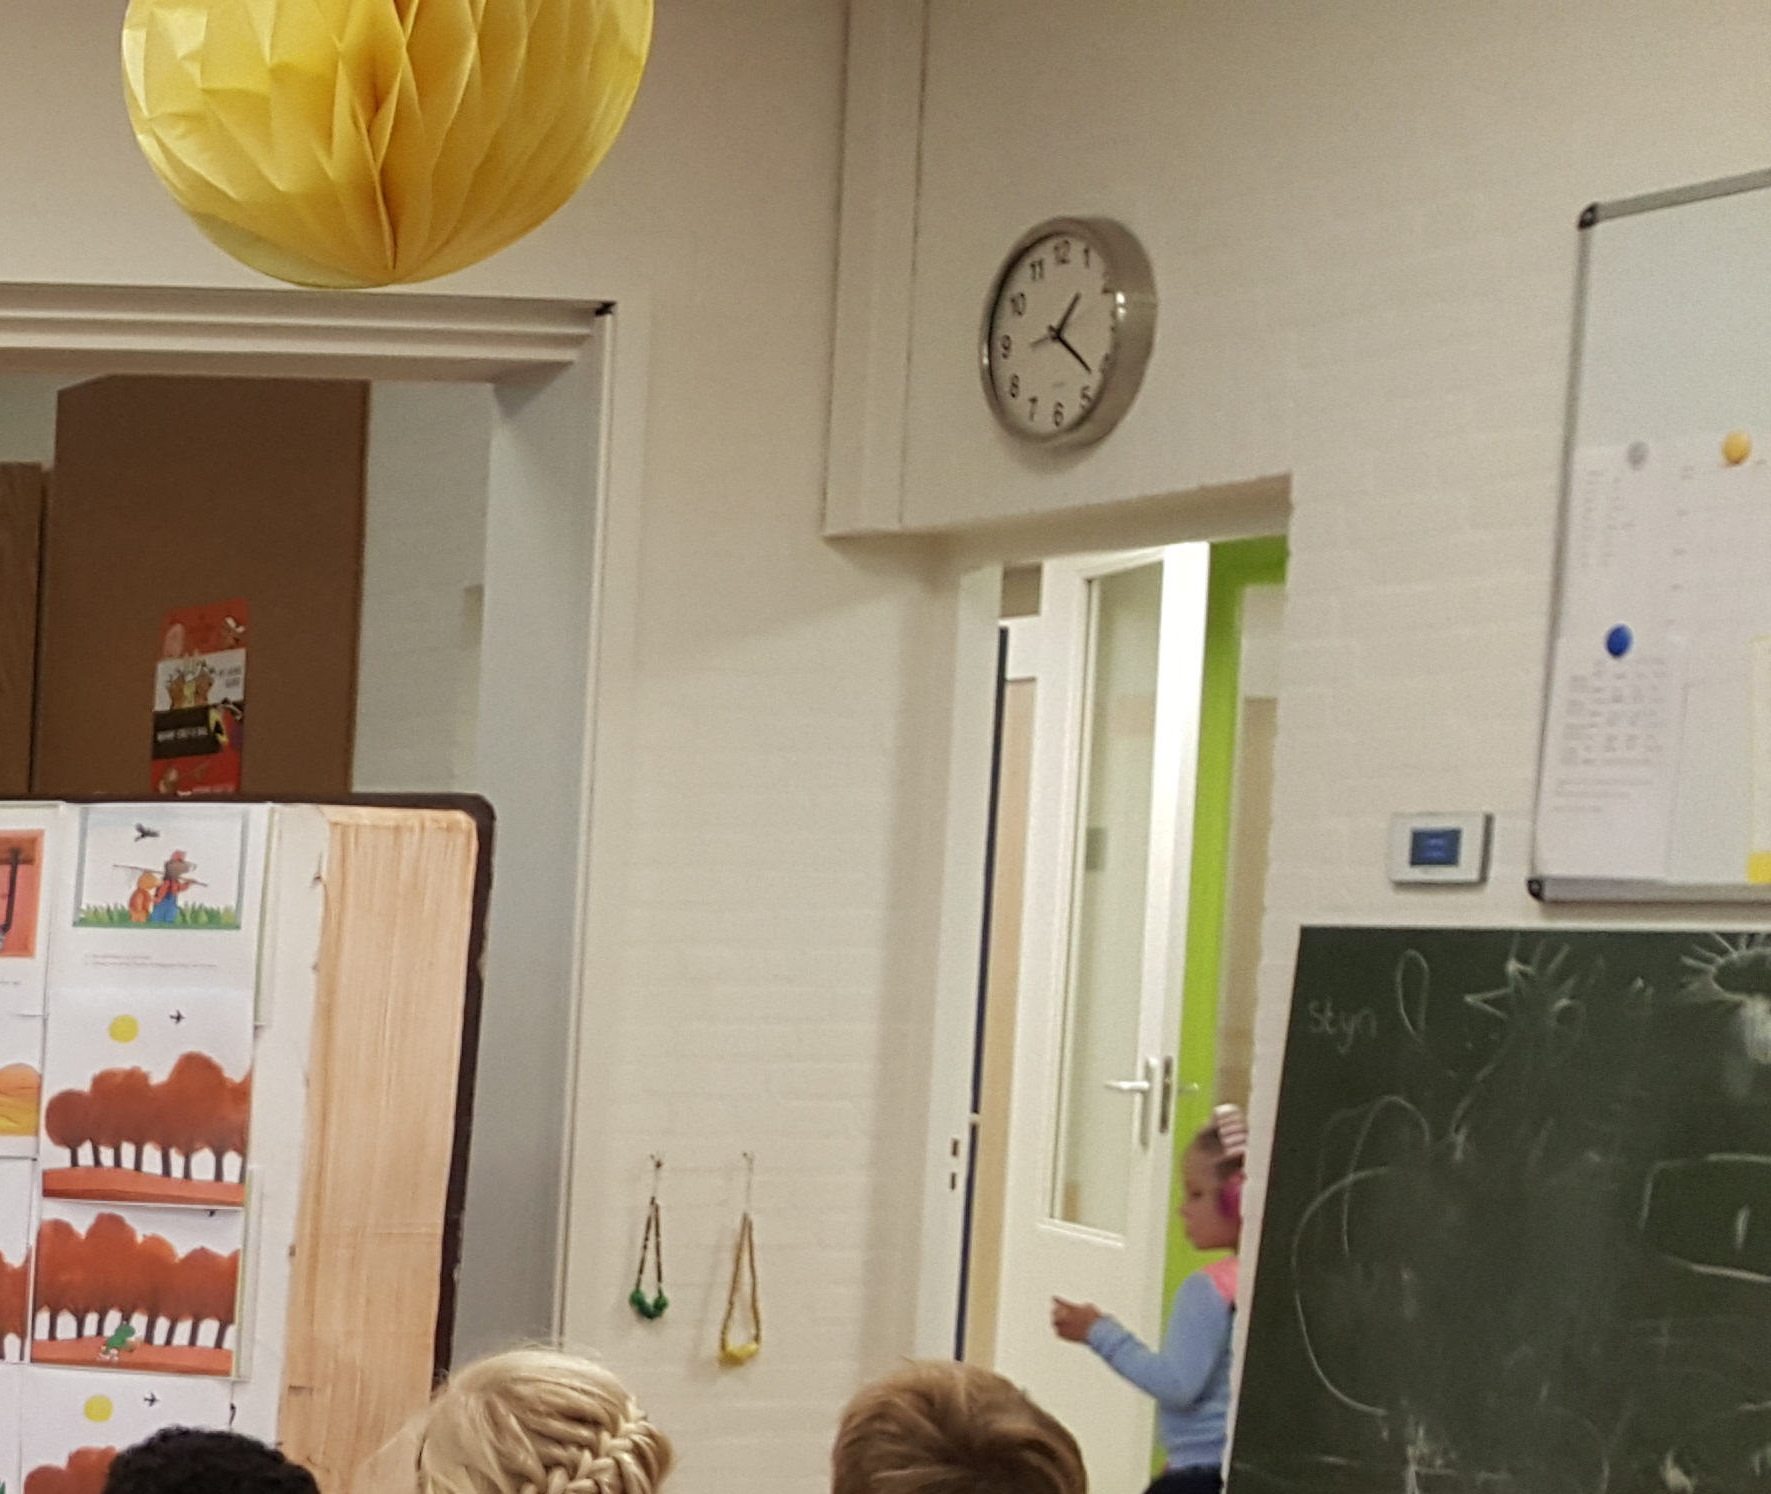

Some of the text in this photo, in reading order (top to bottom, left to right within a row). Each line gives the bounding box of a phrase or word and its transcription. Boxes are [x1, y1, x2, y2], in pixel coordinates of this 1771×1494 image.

[1054, 239, 1071, 265] 12
[1083, 247, 1090, 269] 1
[1030, 258, 1044, 282] 11
[1010, 292, 1026, 317] 10
[1001, 334, 1011, 359] 9
[1009, 374, 1020, 398] 8
[1028, 395, 1038, 421] 7
[1054, 402, 1063, 427] 6
